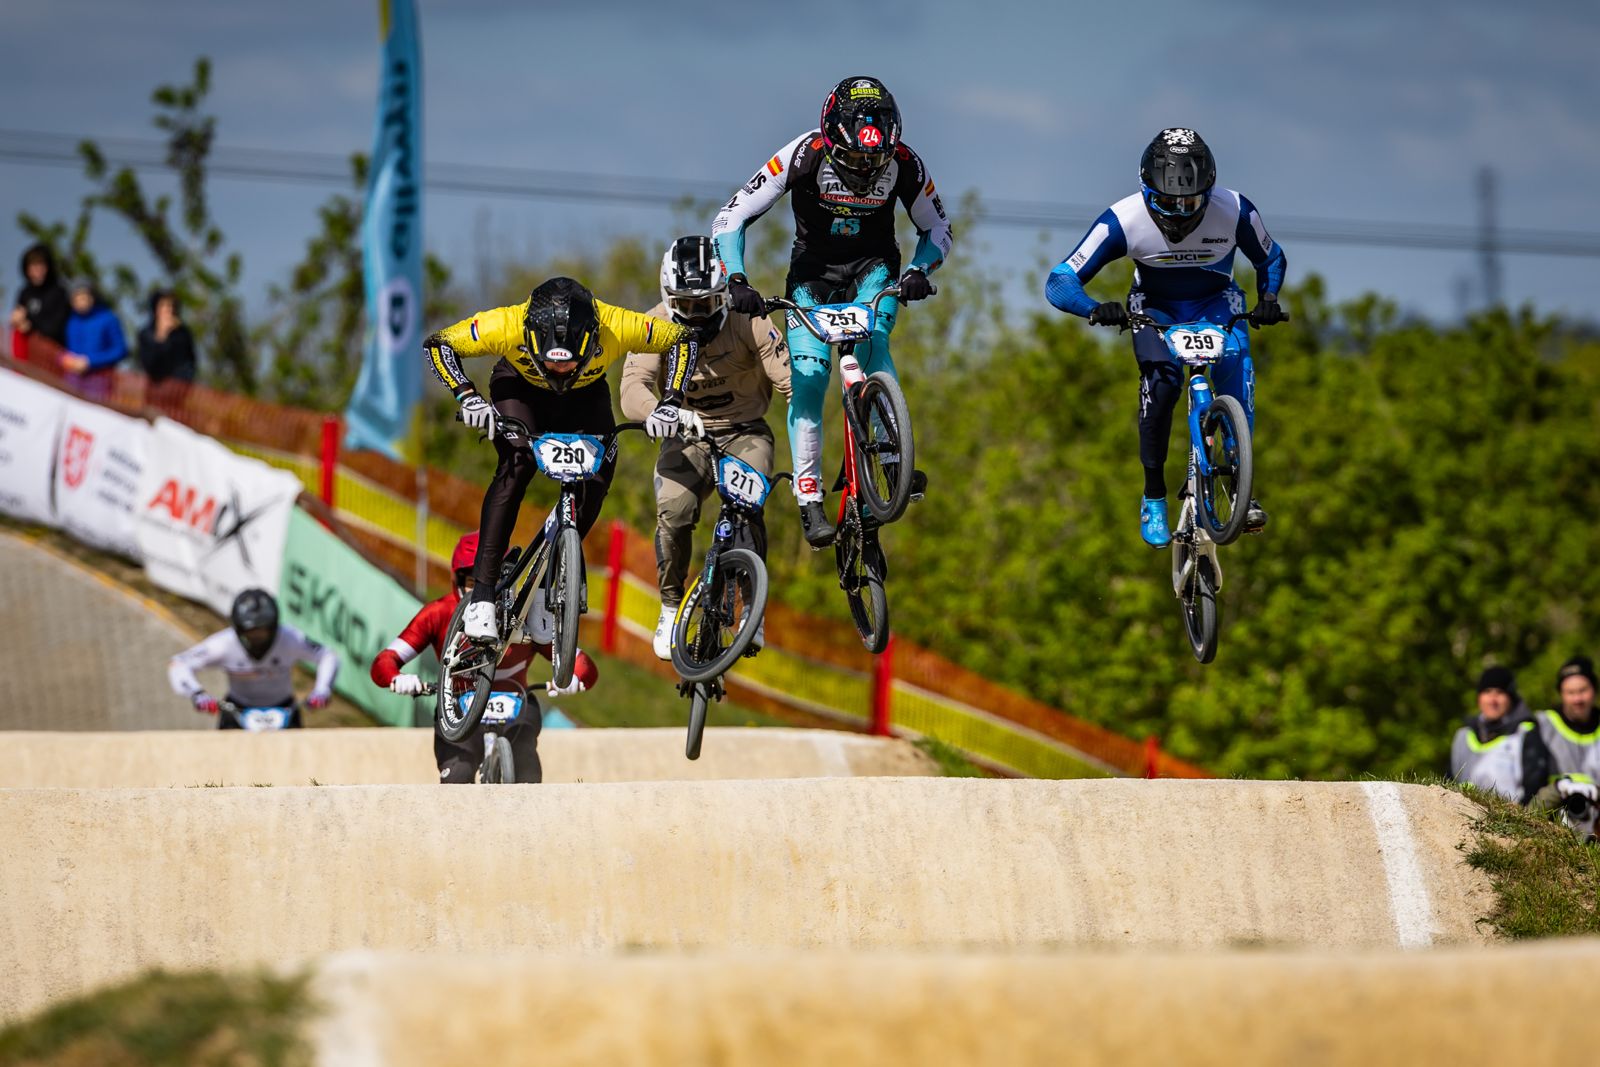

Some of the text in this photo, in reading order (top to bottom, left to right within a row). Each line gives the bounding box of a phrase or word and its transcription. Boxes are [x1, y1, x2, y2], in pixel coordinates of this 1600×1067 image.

[863, 129, 879, 143] 24
[1167, 175, 1193, 187] FLY
[823, 193, 883, 205] WEGENBOUW
[827, 312, 858, 327] 257
[1182, 335, 1214, 350] 259
[552, 446, 585, 465] 250
[730, 470, 754, 495] 271
[486, 701, 505, 713] 43
